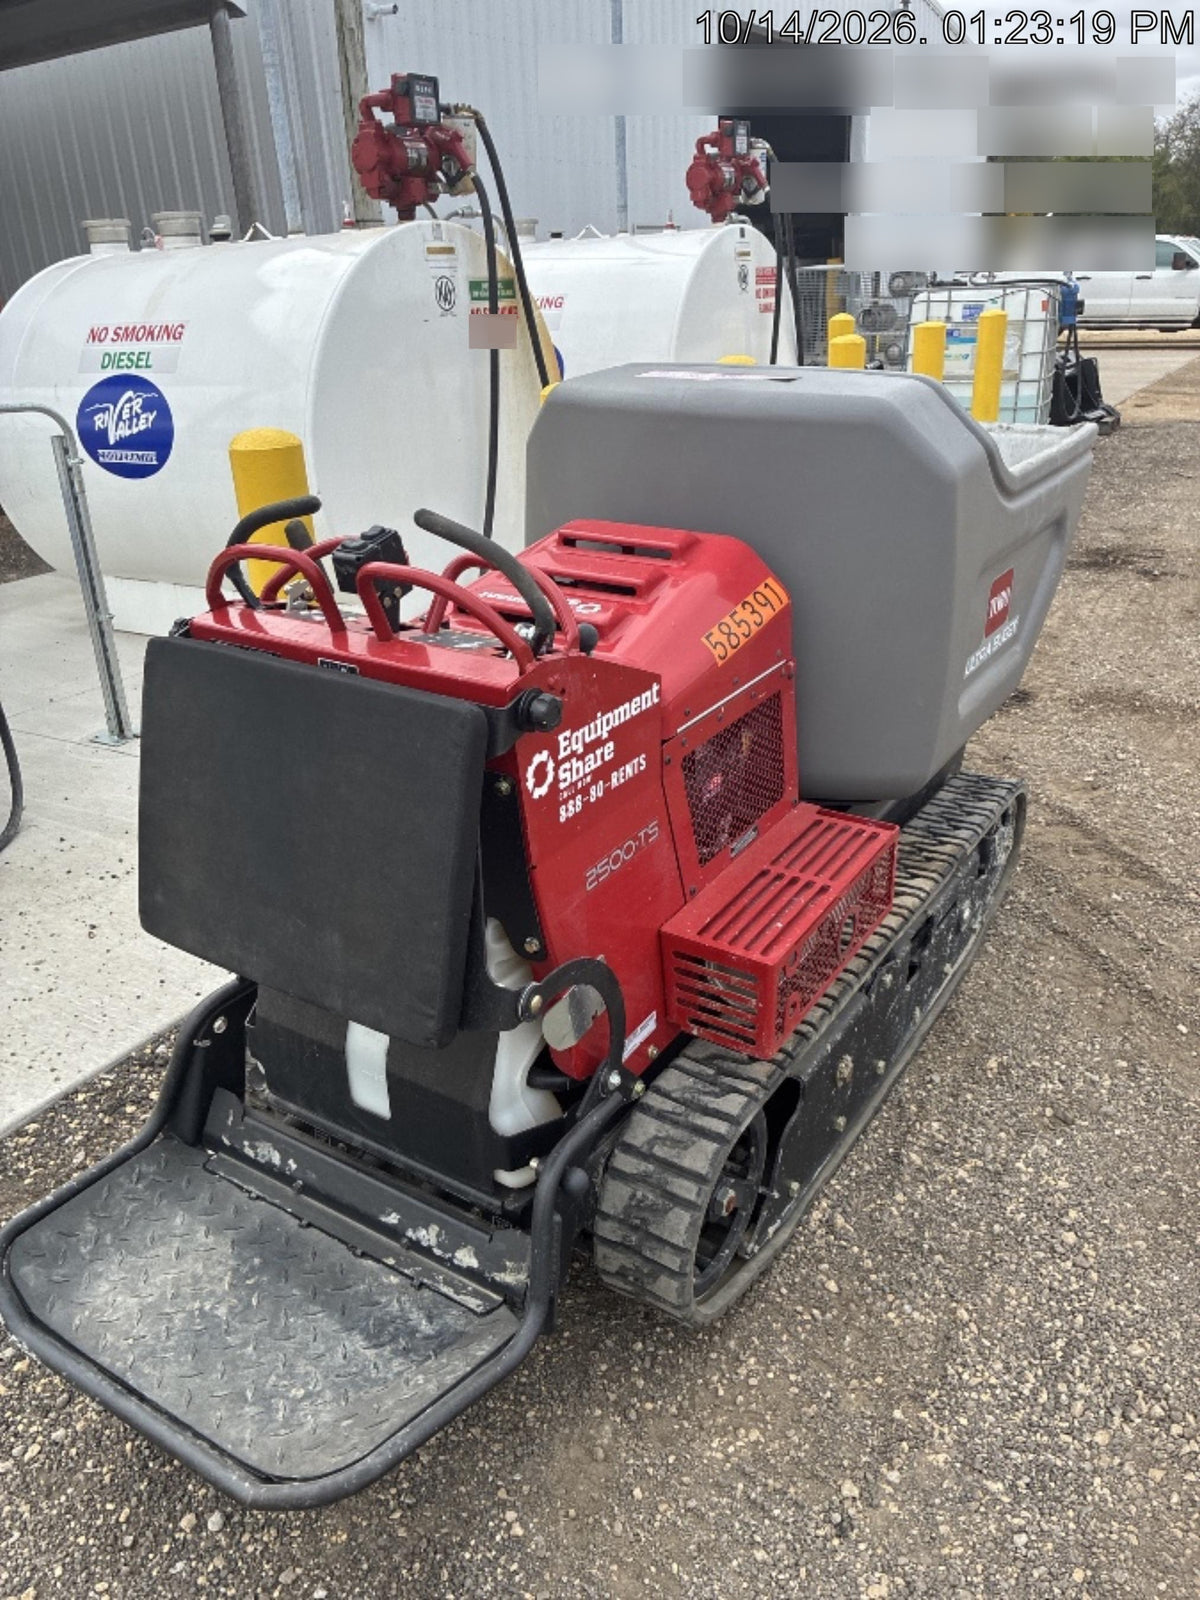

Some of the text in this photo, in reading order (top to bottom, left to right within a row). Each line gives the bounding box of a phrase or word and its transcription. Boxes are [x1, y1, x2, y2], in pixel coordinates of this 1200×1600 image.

[86, 322, 186, 344] NO SMOKING
[100, 351, 153, 370] DIESEL
[93, 391, 143, 445] RIVER
[704, 582, 783, 661] 585391
[557, 681, 661, 761] Equipment
[557, 740, 615, 790] Share
